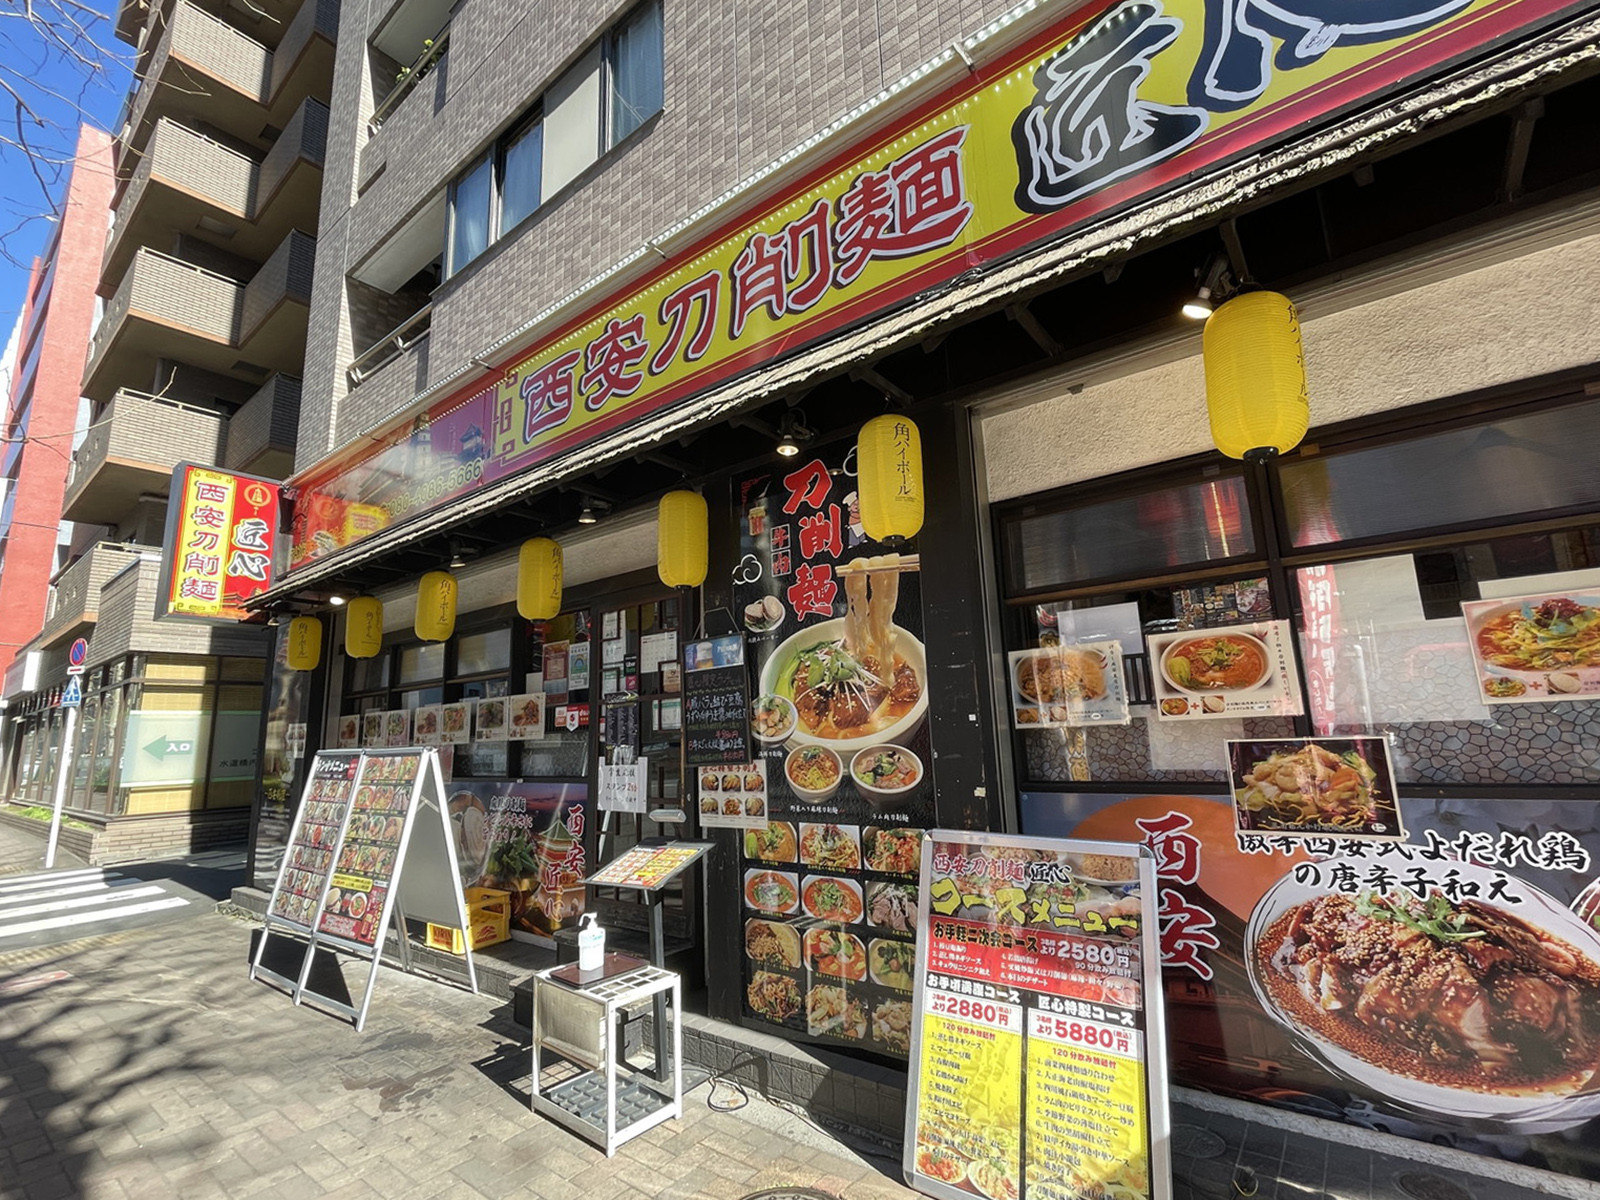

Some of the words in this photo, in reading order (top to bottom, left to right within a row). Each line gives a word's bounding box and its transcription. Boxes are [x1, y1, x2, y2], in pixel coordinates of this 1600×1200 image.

[893, 422, 912, 495] 角ハイボール
[181, 481, 229, 601] 西安刀削麺
[229, 518, 270, 581] 匠心
[165, 743, 190, 752] 入口
[567, 804, 586, 878] 西安
[933, 853, 1026, 882] 西安刀削麺
[1029, 860, 1071, 884] 匠心
[1294, 862, 1525, 906] の唐辛子和え
[930, 877, 1139, 933] コースメニュー
[1057, 940, 1116, 966] 2580
[946, 997, 996, 1022] 2880
[998, 1013, 1008, 1026] 円
[1038, 995, 1135, 1027] 匠心特製コース
[1055, 1019, 1113, 1048] 5880
[1117, 1039, 1128, 1052] 円
